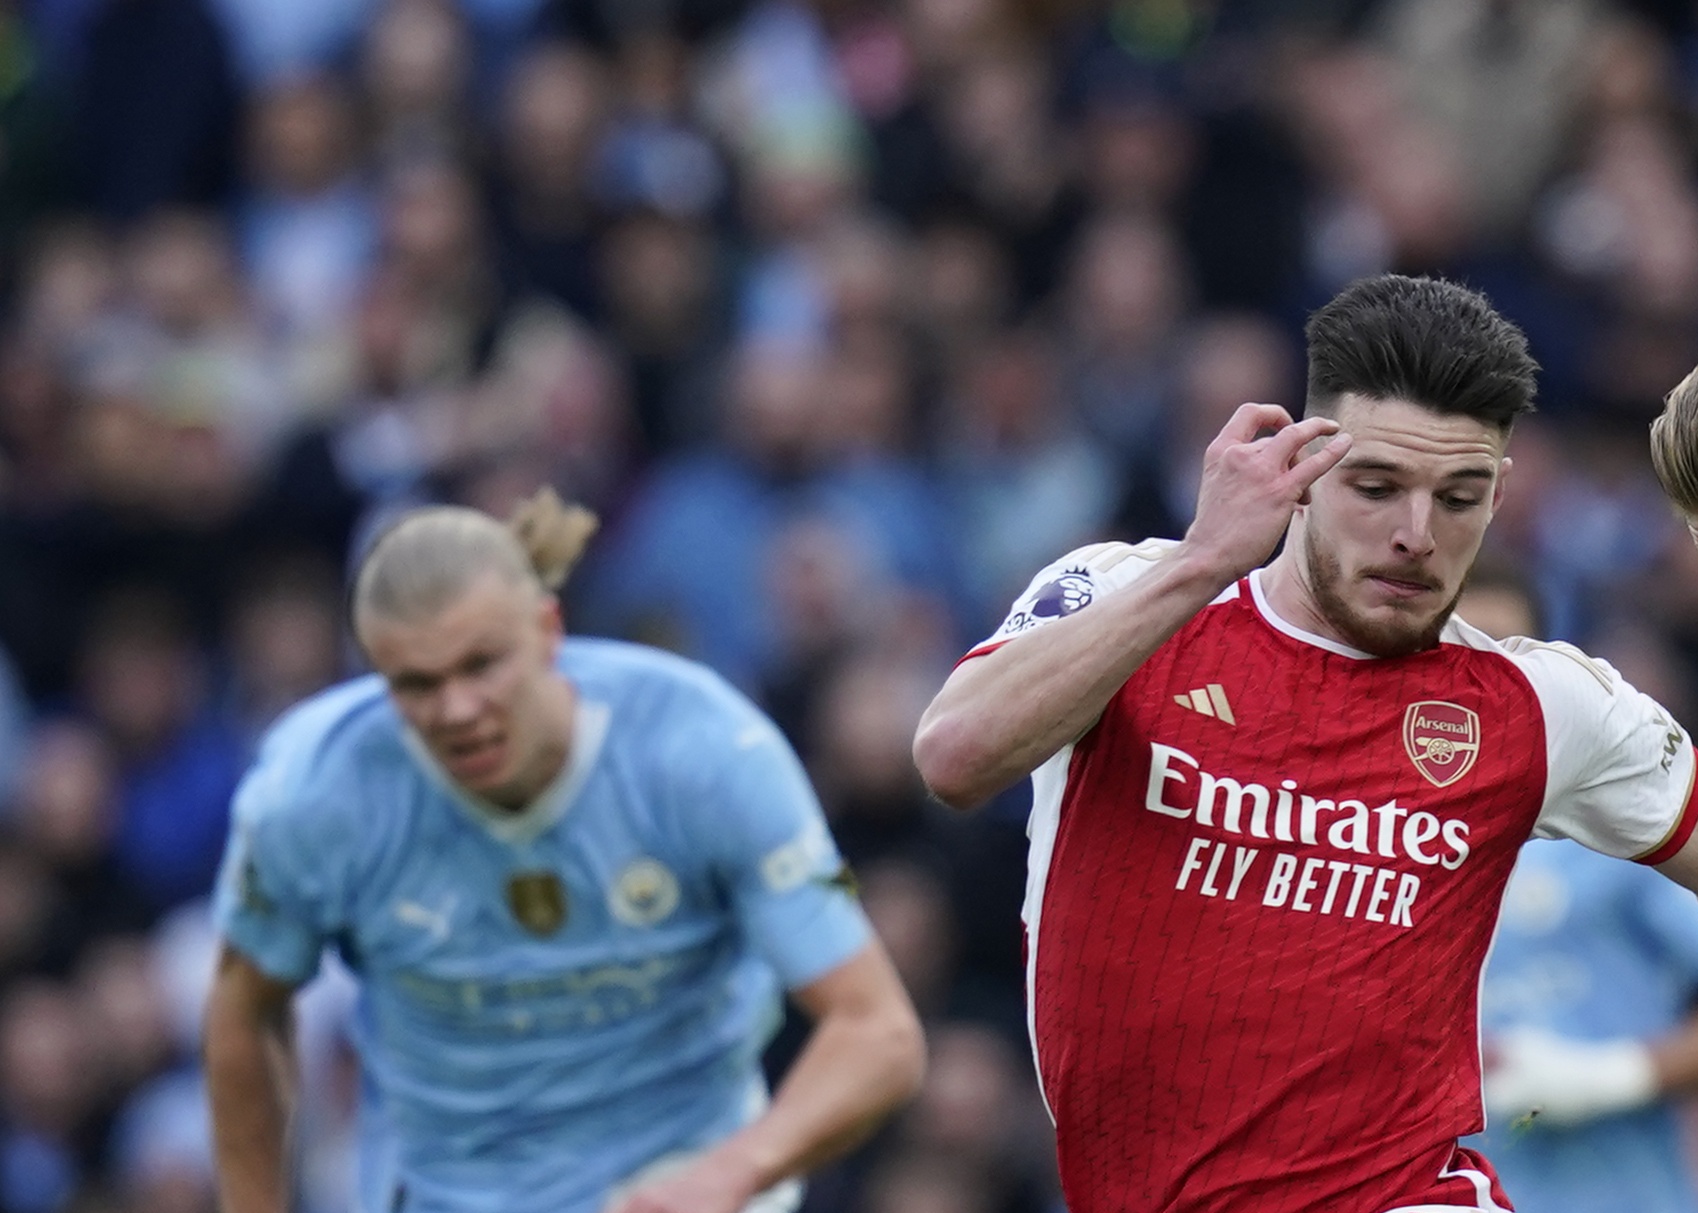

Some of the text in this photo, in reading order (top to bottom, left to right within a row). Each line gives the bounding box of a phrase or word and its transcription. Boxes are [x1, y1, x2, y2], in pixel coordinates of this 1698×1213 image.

[1415, 715, 1469, 735] Arsenal
[1145, 741, 1471, 871] Emirates
[1175, 837, 1421, 928] FLY BETTER
